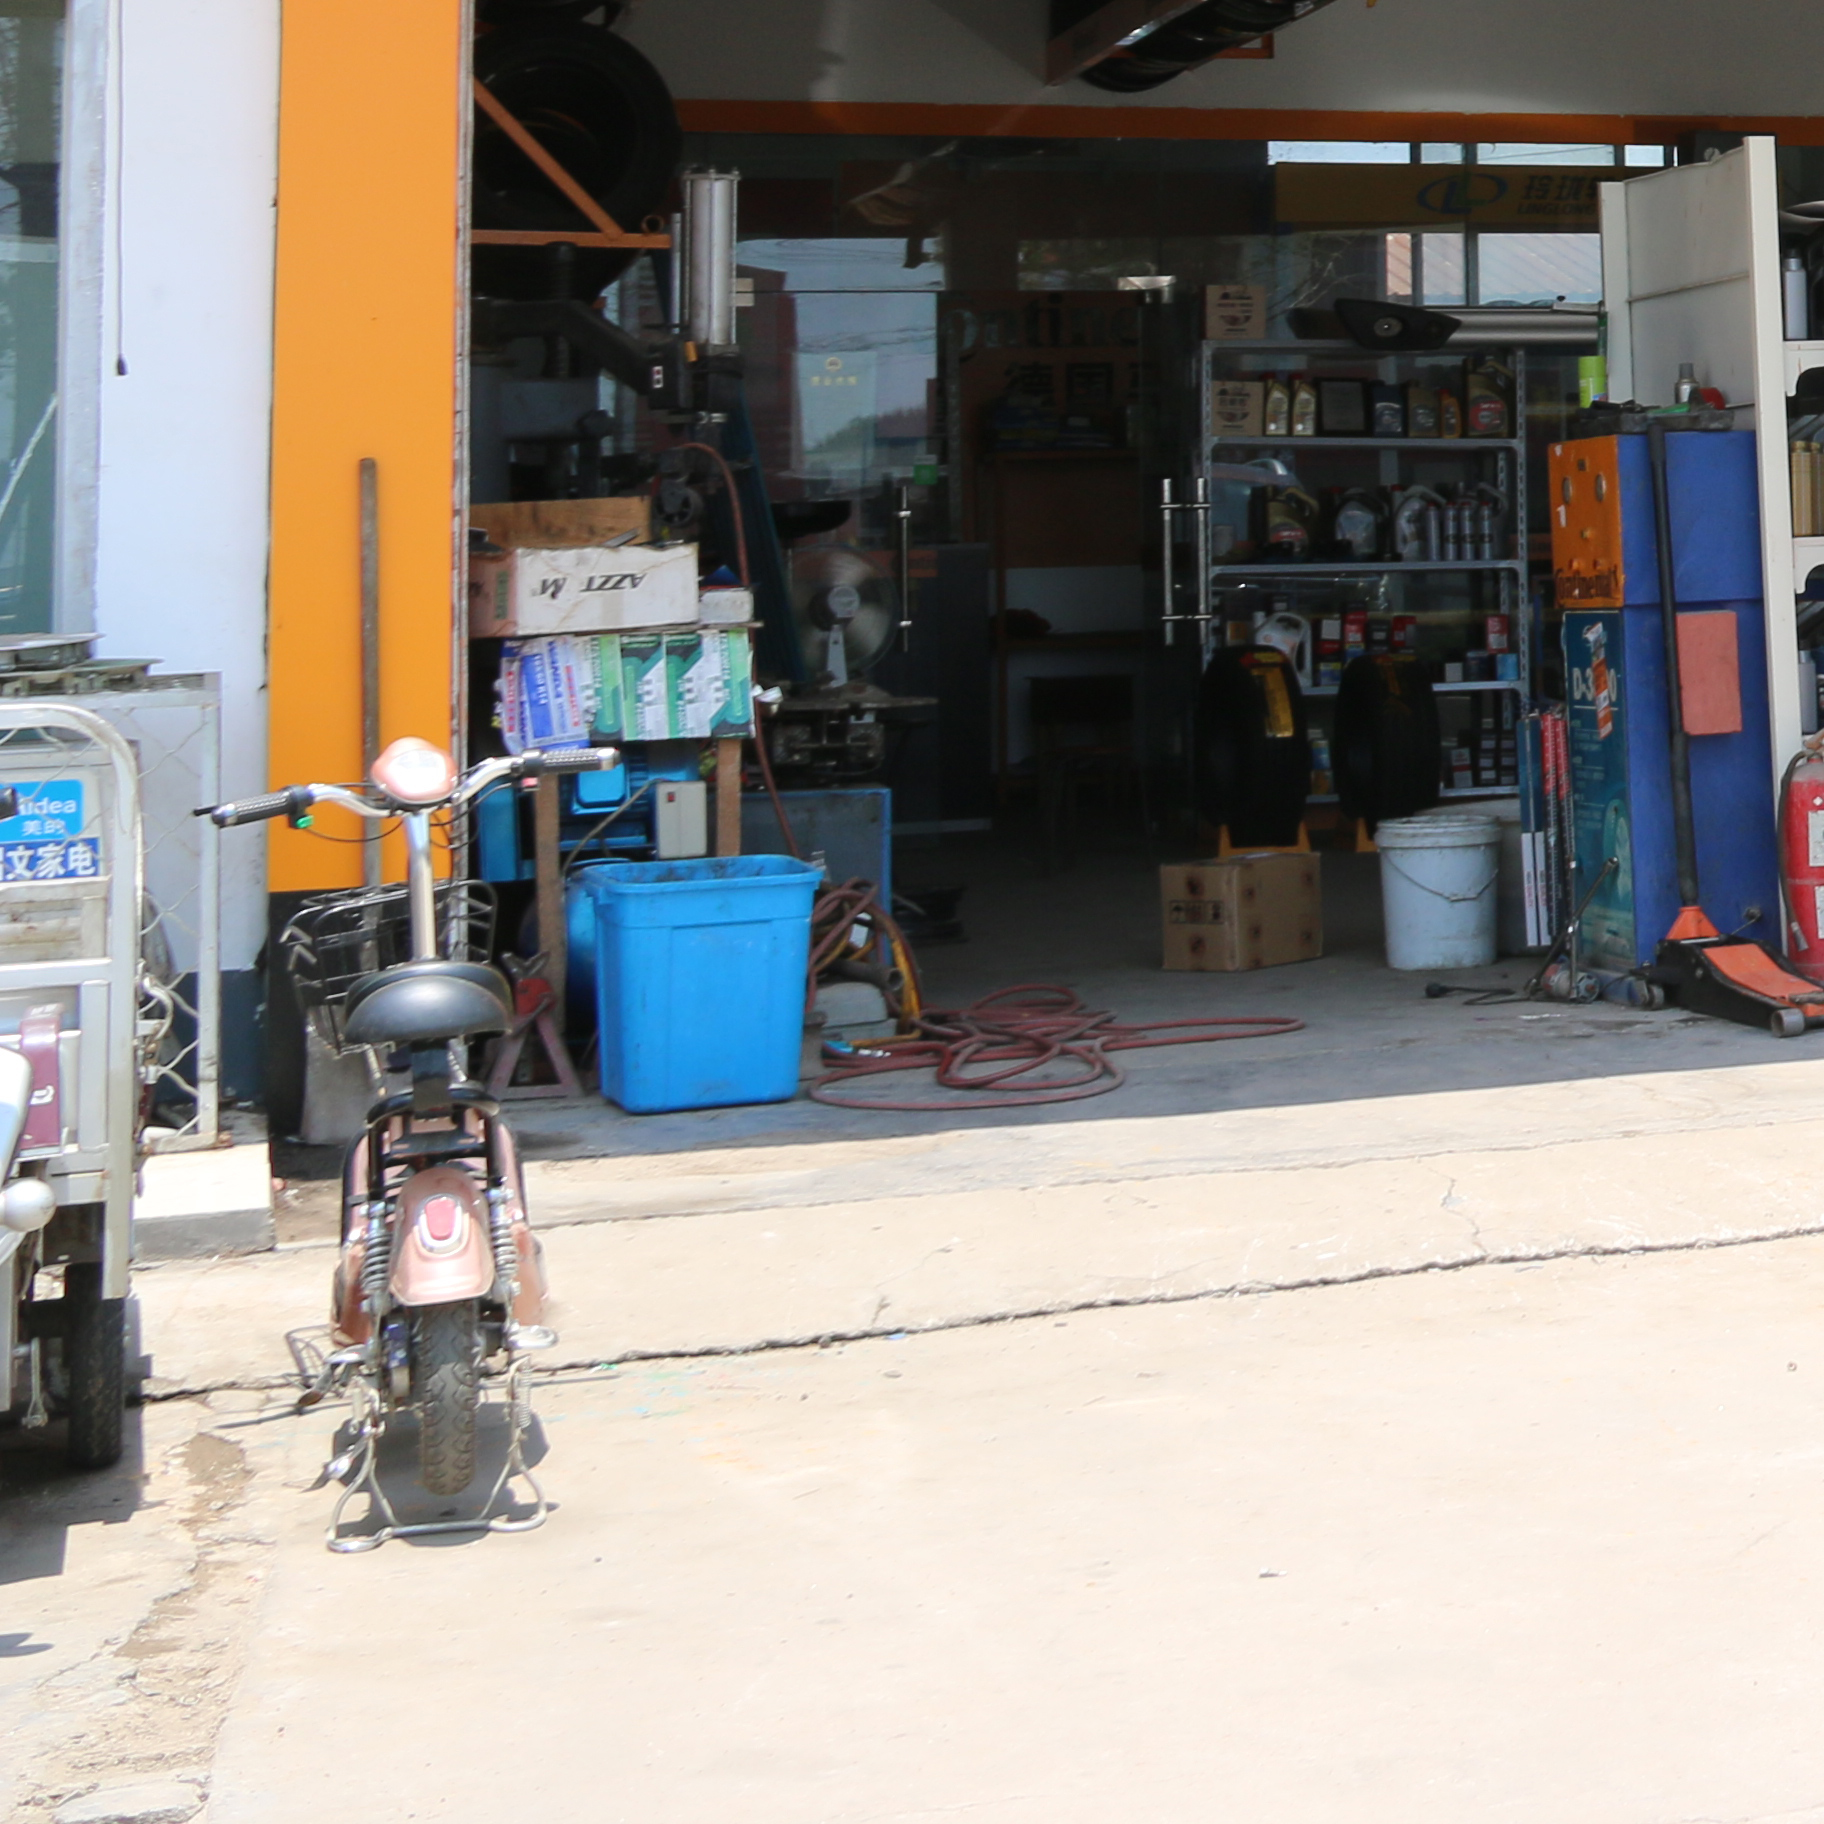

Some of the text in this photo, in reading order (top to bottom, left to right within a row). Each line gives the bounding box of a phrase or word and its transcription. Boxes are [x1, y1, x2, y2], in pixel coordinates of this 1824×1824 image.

[22, 819, 66, 836] 美的
[0, 842, 96, 881] 文家电
